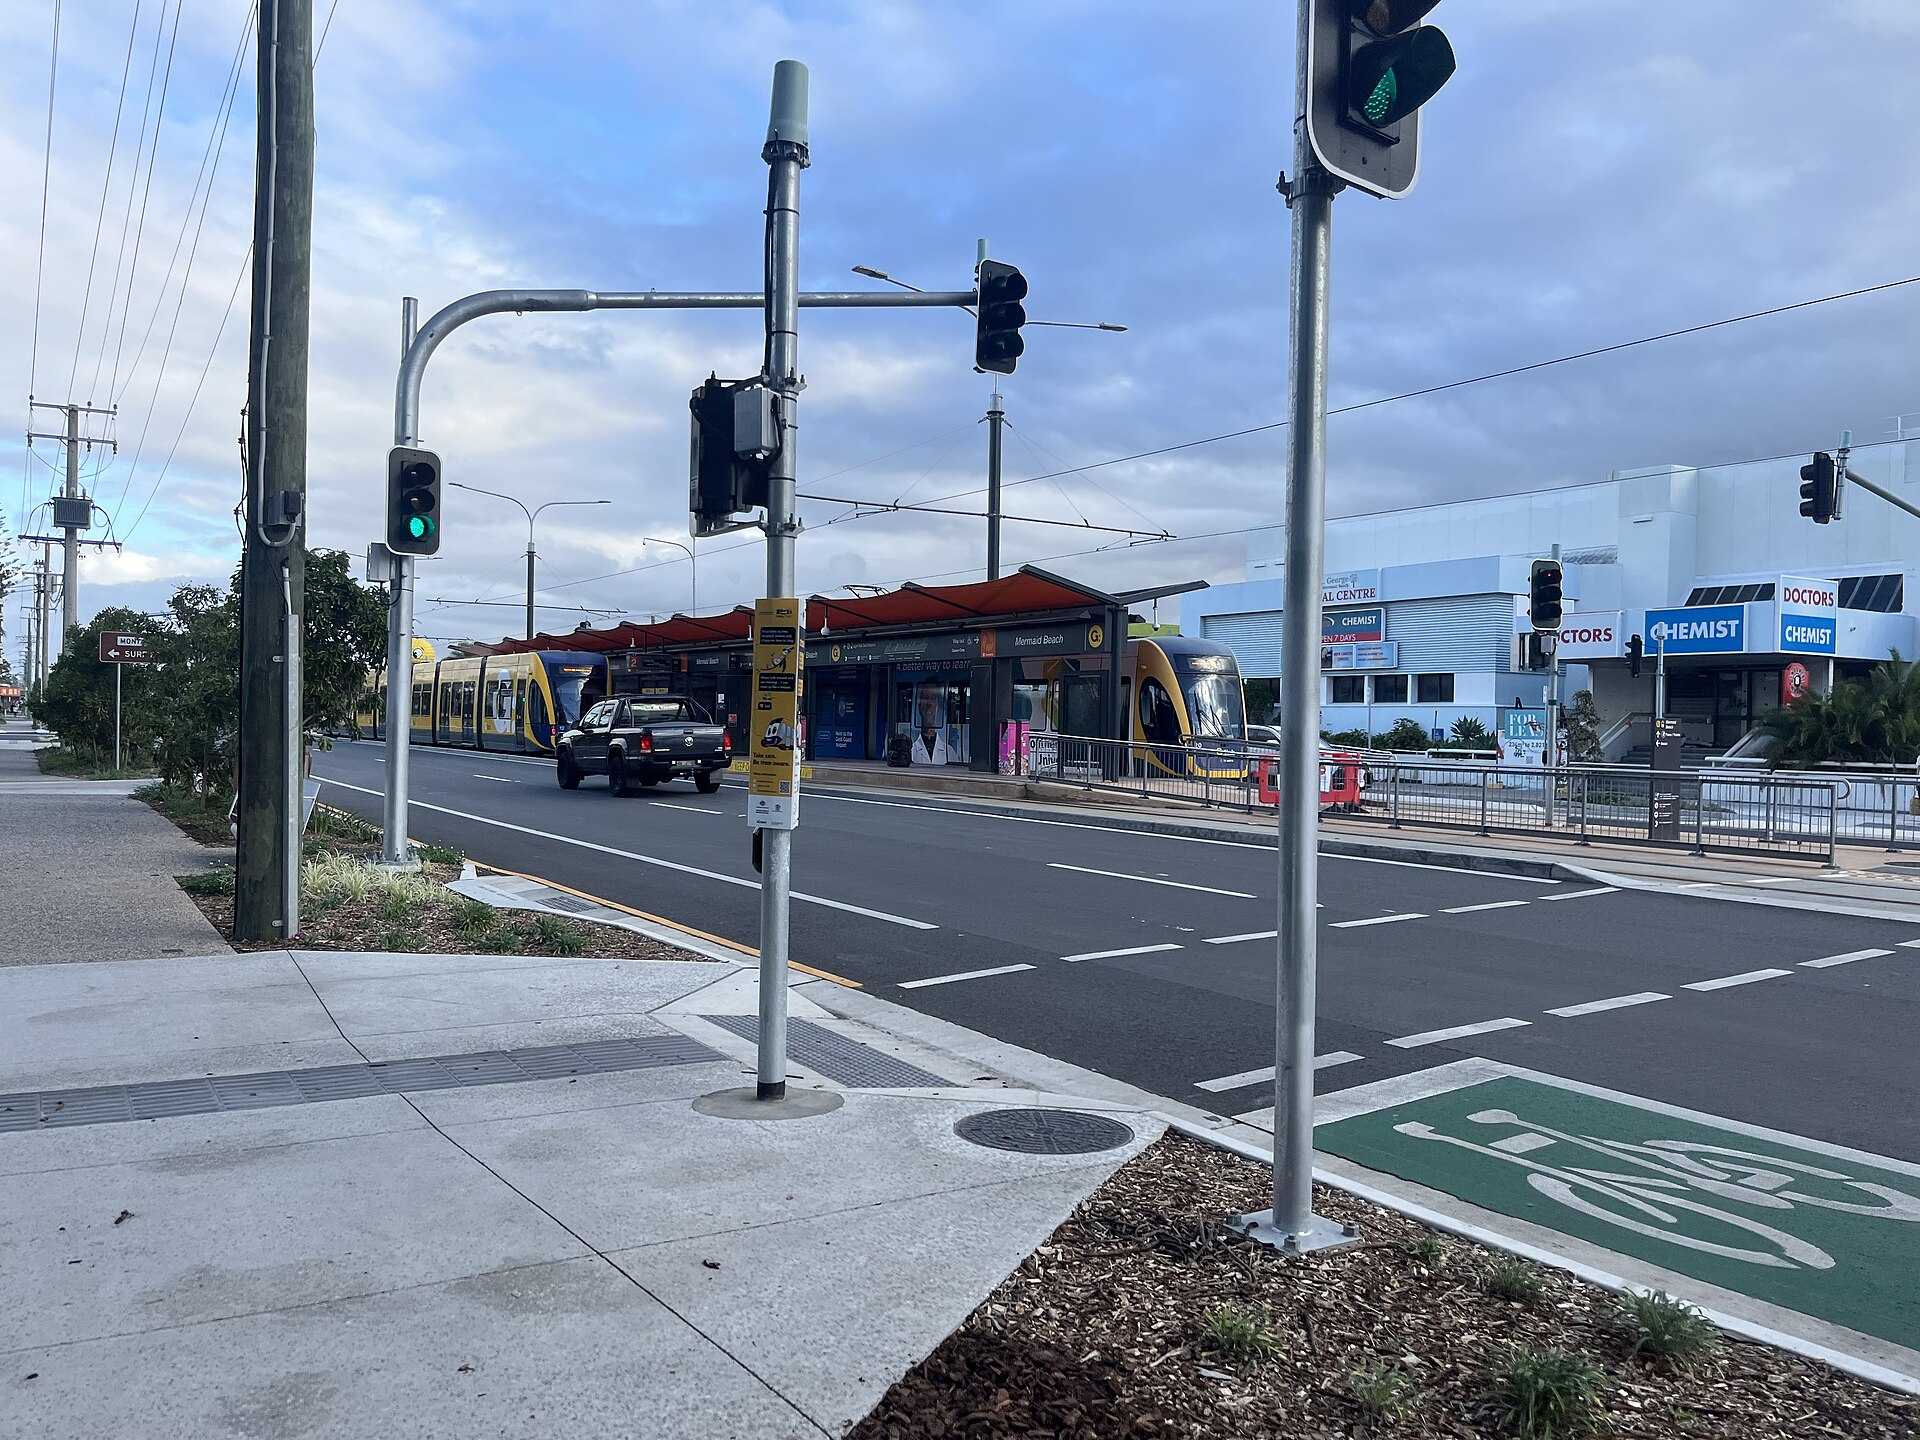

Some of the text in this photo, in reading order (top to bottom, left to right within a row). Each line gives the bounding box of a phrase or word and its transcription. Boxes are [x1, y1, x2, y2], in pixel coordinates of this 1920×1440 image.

[1326, 576, 1349, 585] George
[1336, 588, 1376, 601] CENTRE
[1783, 586, 1834, 607] DOCTORS
[1341, 615, 1377, 626] CHEMIST
[1558, 627, 1613, 644] CTORS
[1649, 619, 1739, 641] CHEMIST
[1785, 625, 1832, 645] CHEMIST
[119, 637, 143, 645] MONT
[1015, 634, 1064, 646] Mermaid Beach
[1334, 634, 1339, 642] 7
[1340, 633, 1356, 642] DAYS
[630, 658, 637, 668] 2
[902, 662, 924, 671] better
[926, 661, 942, 672] way
[942, 660, 951, 670] to
[1509, 713, 1537, 725] FOR
[1509, 725, 1544, 737] LEAS
